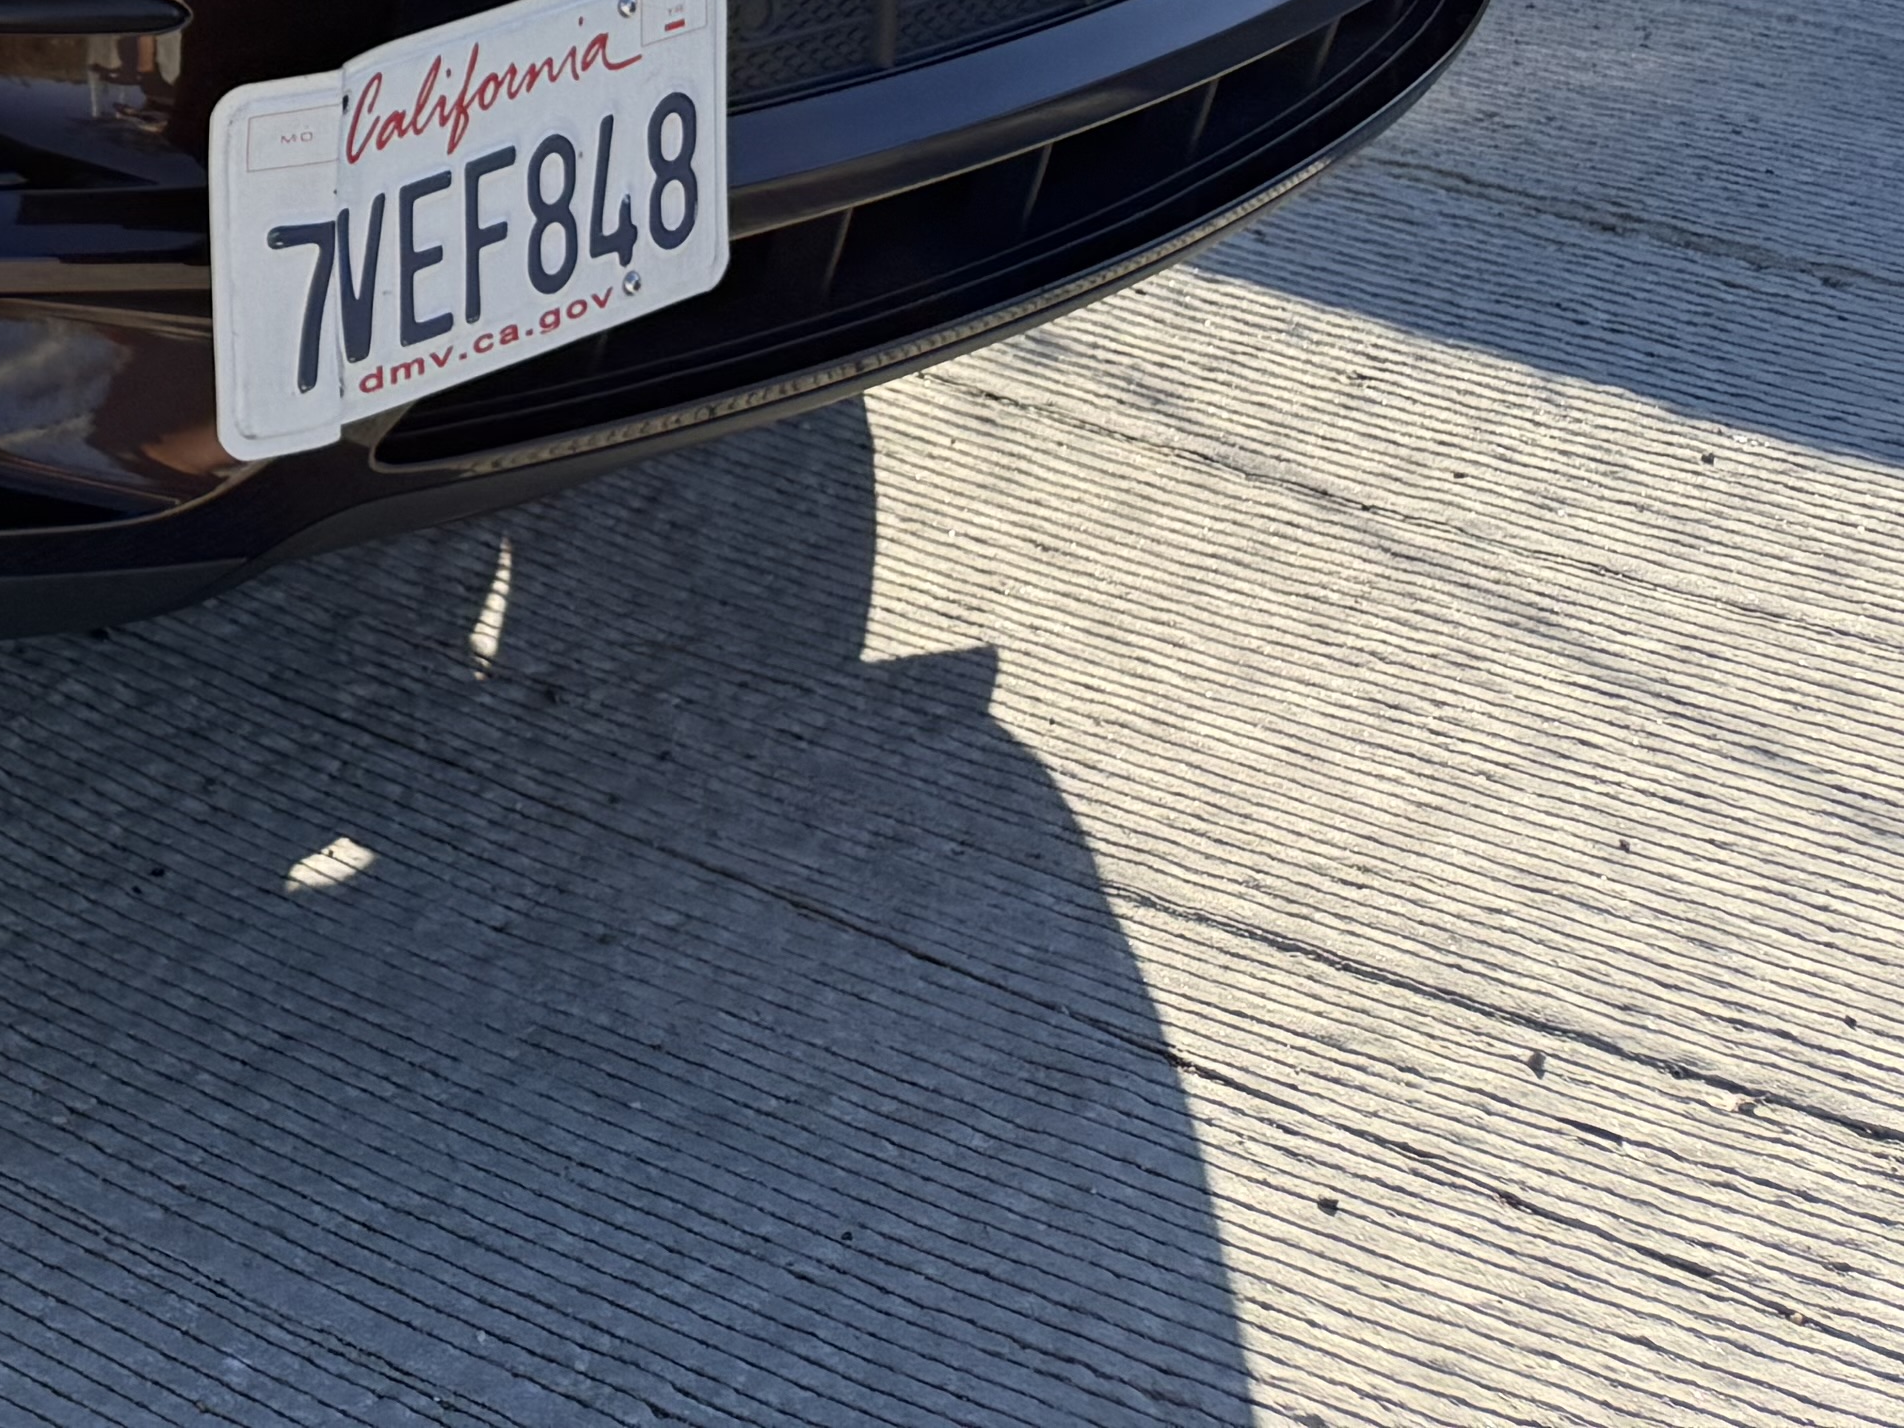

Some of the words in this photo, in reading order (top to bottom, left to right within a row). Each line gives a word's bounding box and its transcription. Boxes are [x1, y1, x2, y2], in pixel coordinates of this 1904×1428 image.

[279, 130, 314, 145] MO
[346, 16, 642, 164] California
[267, 92, 699, 394] 7VEF848
[358, 286, 614, 394] dmv.ca.gov
